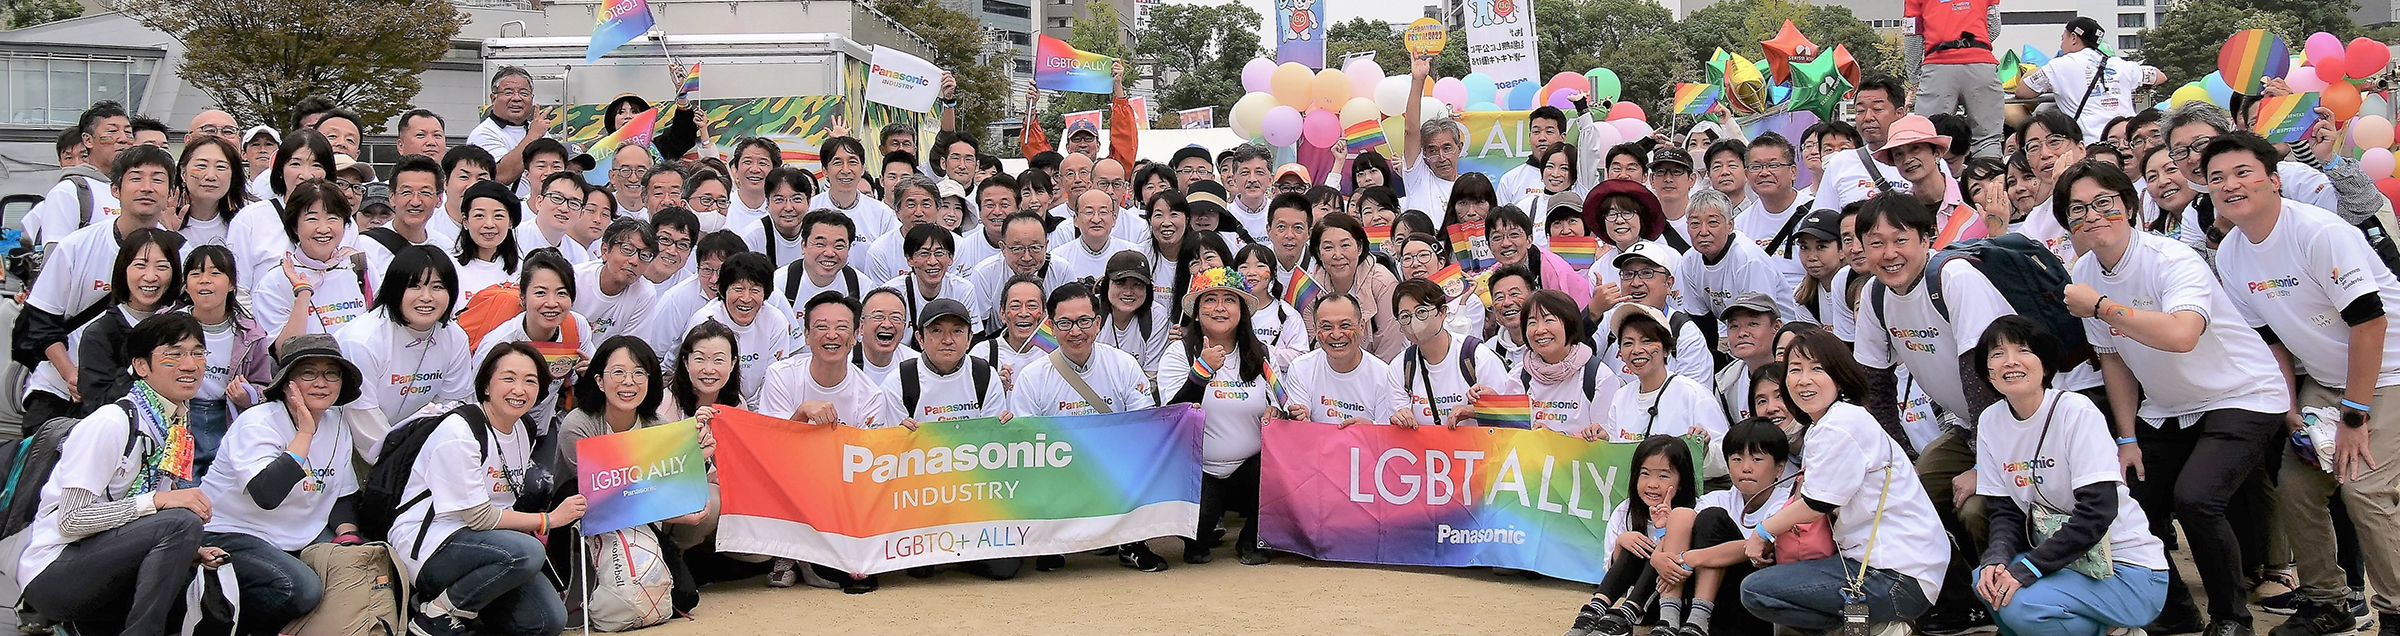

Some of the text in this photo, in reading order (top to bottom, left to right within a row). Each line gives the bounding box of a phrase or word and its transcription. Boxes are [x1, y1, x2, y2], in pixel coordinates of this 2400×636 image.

[1046, 56, 1108, 71] LGBTQ ALLY
[871, 63, 929, 87] Panasonic
[881, 79, 914, 91] INDUSTRY
[1858, 179, 1909, 190] Panonic
[1632, 243, 1645, 253] P
[308, 298, 364, 316] Panasonic
[390, 369, 443, 385] Panasonic
[1209, 378, 1257, 388] anasonic
[1214, 389, 1249, 401] Group
[924, 400, 981, 416] Panasonic
[1059, 396, 1113, 411] Panasic
[1320, 395, 1365, 412] Panasonic
[1071, 408, 1098, 416] INDUST
[1423, 406, 1452, 417] Goup
[1535, 410, 1568, 424] Group
[842, 433, 1073, 484] Panasonic
[2003, 456, 2056, 473] Panaonic
[591, 454, 688, 491] LGBTQ ALLY
[493, 482, 513, 494] Gro
[623, 485, 658, 497] Panasonic
[1349, 447, 1618, 522] LGBT ALLY
[892, 479, 1021, 511] INDUSTRY
[1437, 524, 1526, 546] Panasonic
[884, 526, 1032, 561] LGBTQ+ ALLY
